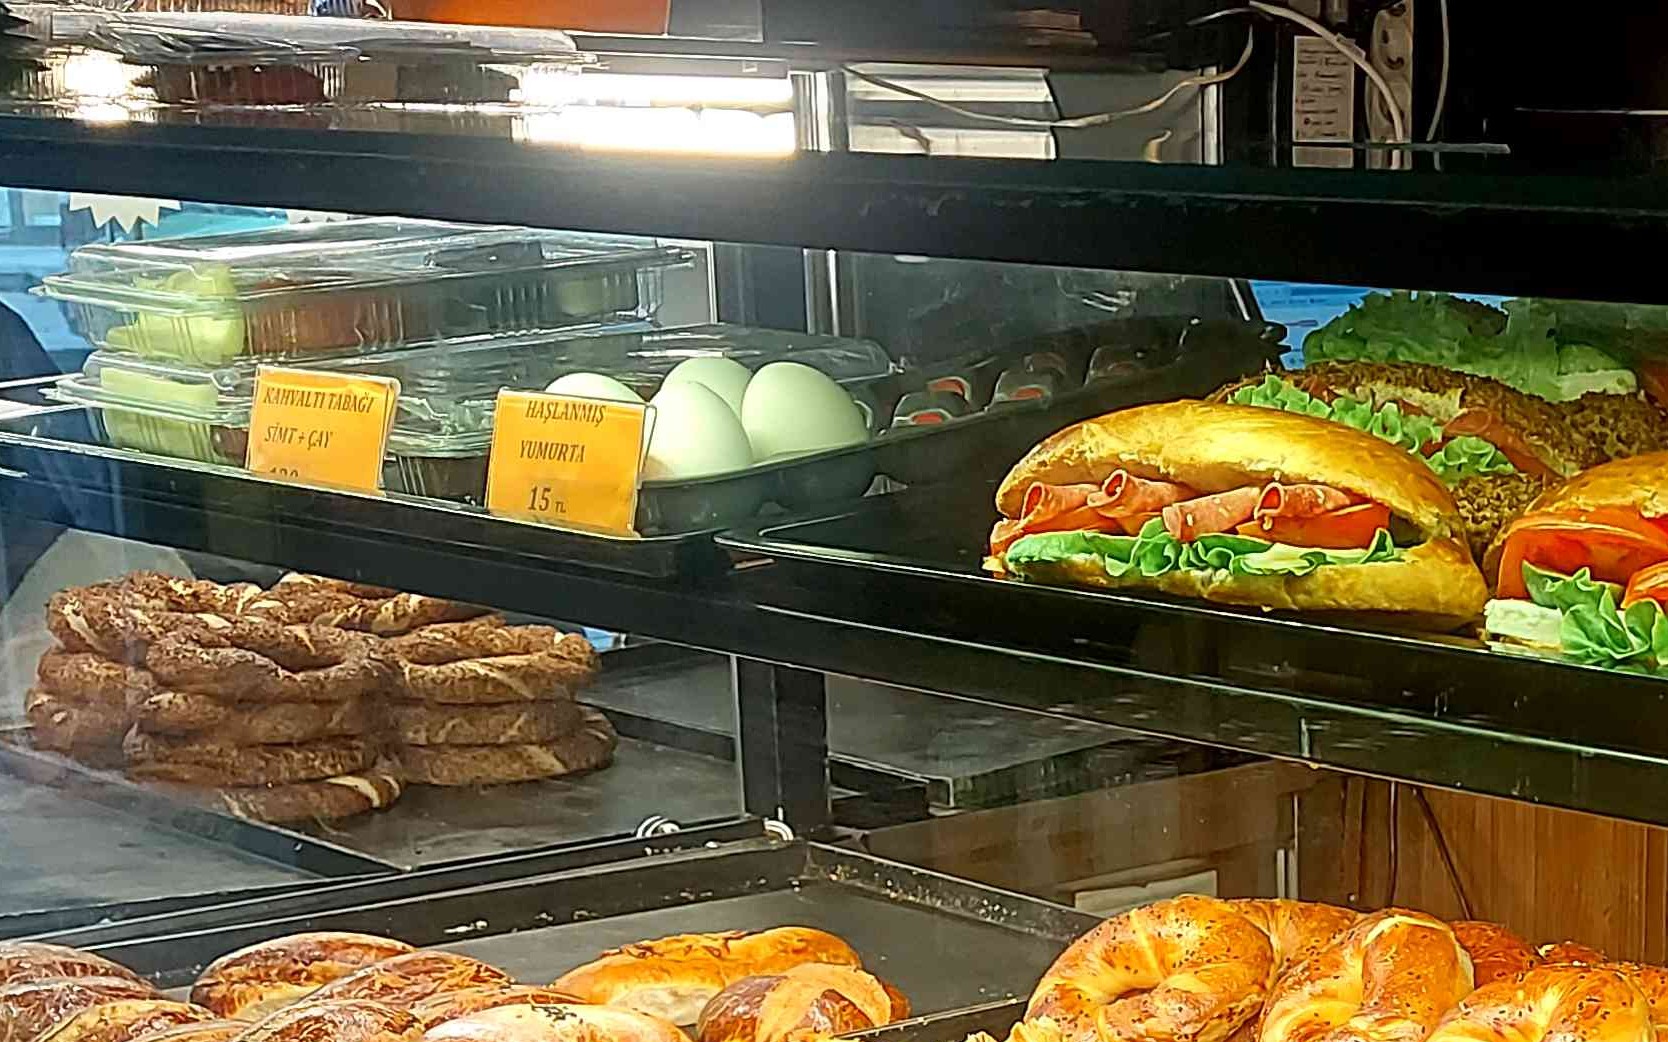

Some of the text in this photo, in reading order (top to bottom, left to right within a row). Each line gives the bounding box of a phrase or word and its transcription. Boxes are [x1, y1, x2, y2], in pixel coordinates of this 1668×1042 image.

[263, 387, 326, 409] KAHVALTI
[525, 400, 607, 428] HAŞLANMIŞ
[307, 430, 333, 451] ÇAY
[520, 440, 585, 463] YUMURTA
[528, 485, 551, 511] 15
